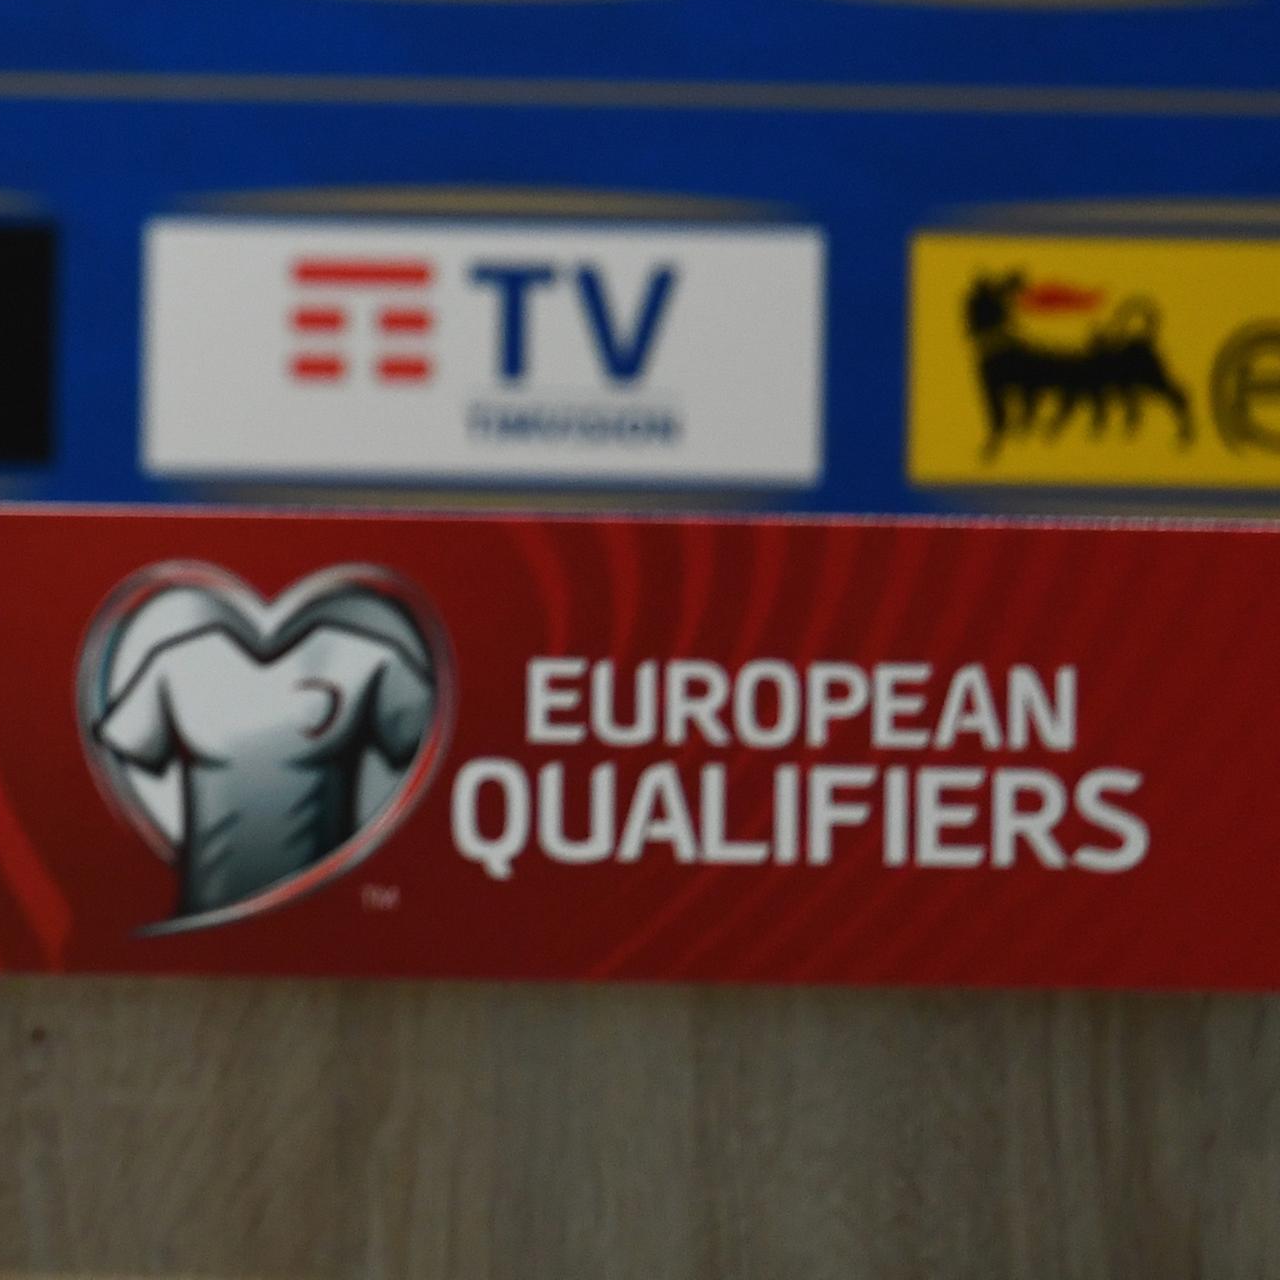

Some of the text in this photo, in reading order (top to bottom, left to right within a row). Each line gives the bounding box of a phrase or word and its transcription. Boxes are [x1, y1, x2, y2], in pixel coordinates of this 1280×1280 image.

[468, 260, 678, 384] TV
[526, 658, 1076, 750] EUROPEAN
[450, 758, 1150, 878] QUALIFIERS
